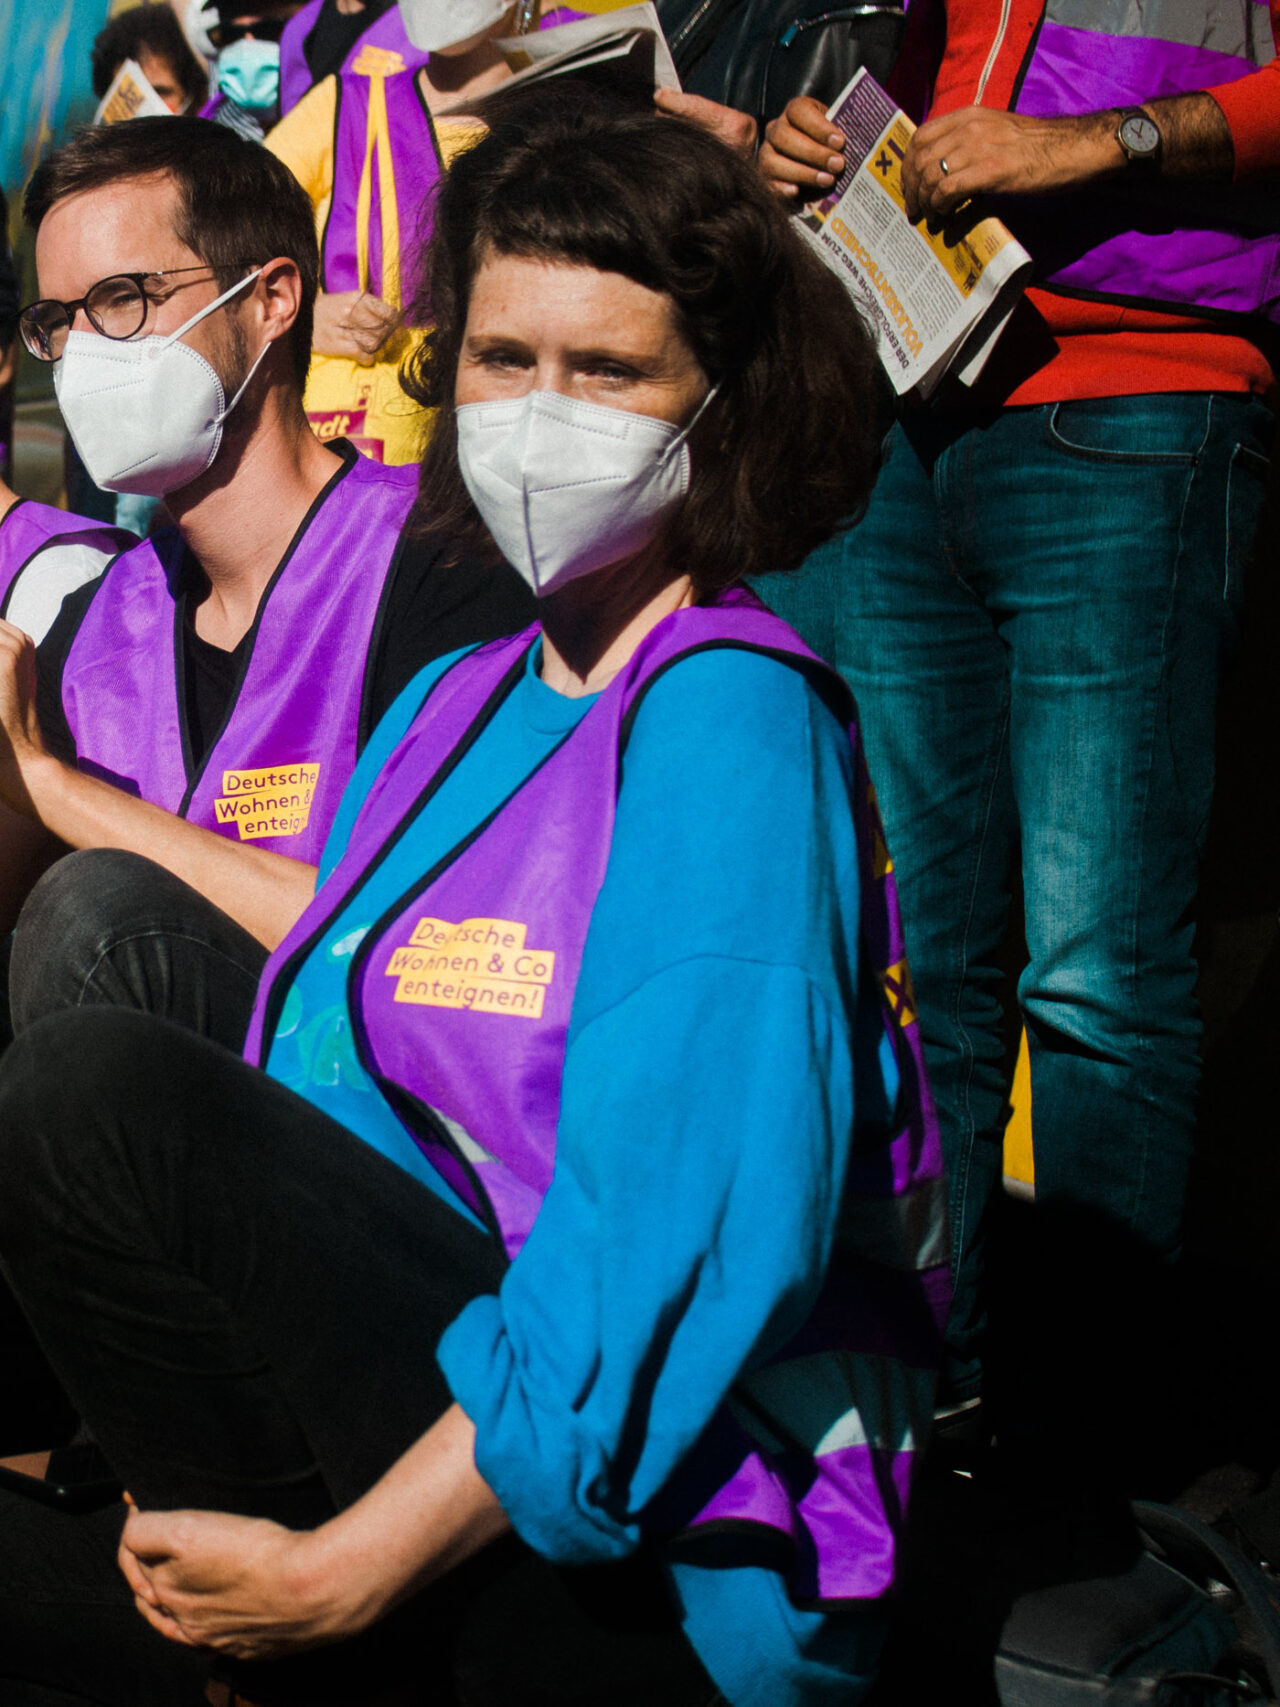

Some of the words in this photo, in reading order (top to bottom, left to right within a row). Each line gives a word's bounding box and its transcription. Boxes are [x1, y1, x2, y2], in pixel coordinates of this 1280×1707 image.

[819, 230, 842, 255] ZUM
[838, 252, 861, 279] WEG
[827, 215, 924, 358] VOLKSENTSCHEID
[855, 275, 900, 347] ERFOLGREICHE
[894, 346, 910, 369] DER
[227, 768, 316, 791] Deutsche
[219, 795, 300, 818] Wohnen
[245, 813, 305, 834] enteig
[487, 953, 505, 974] &
[514, 956, 547, 977] Co
[403, 979, 539, 1010] enteignen!
